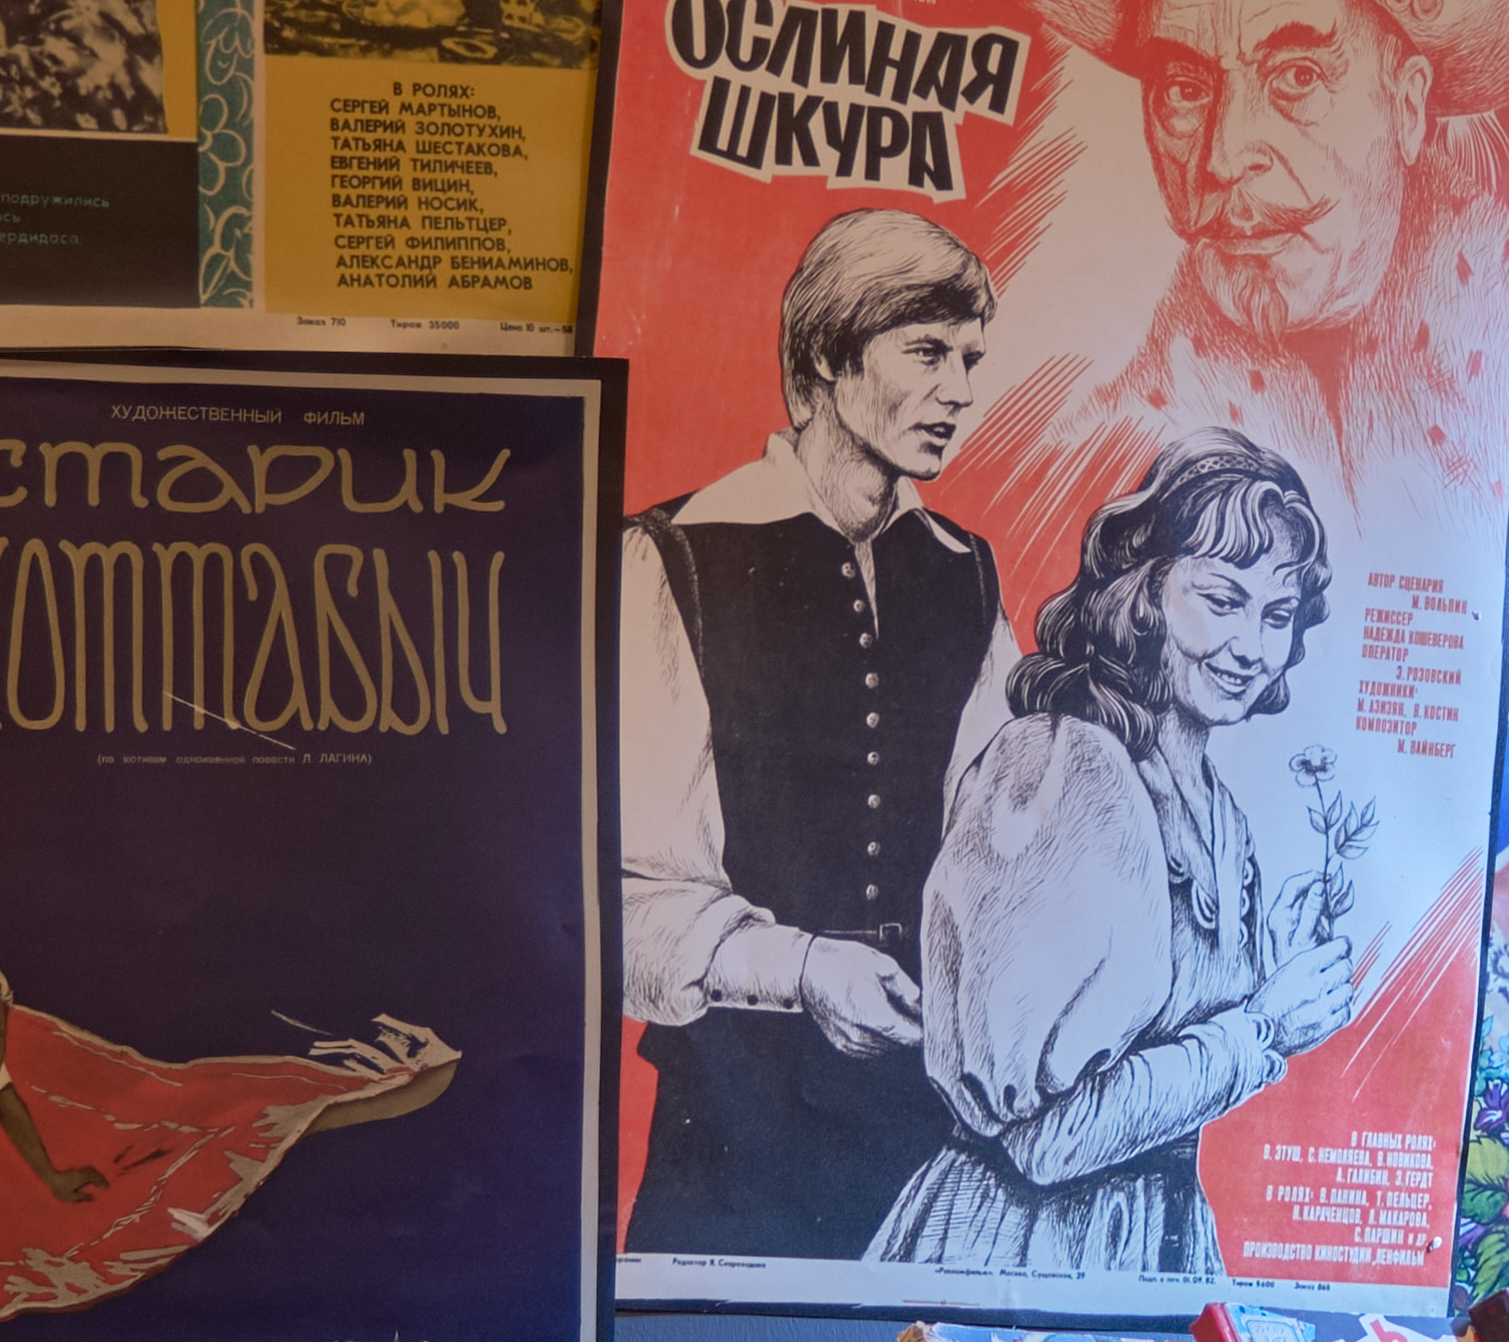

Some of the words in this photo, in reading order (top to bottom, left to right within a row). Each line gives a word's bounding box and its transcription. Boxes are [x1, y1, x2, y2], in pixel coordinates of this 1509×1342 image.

[392, 81, 402, 96] В
[412, 83, 475, 99] РОЛЯХ:
[330, 97, 390, 115] СЕРГЕЙ
[399, 102, 501, 122] МАРТЫНОВ,
[330, 116, 406, 134] ВАЛЕРИЙ
[415, 121, 526, 141] ЗОЛОТУХИН,
[696, 73, 956, 193] ШКУРА
[330, 137, 406, 154] ТАТЬЯНА
[415, 139, 529, 159] ШЕСТАКОВА,
[330, 154, 401, 172] ЕВГЕНИЙ
[411, 158, 498, 178] ТИЛИЧЕЕВ,
[330, 174, 403, 191] ГЕОРГИЙ
[411, 177, 474, 196] ВИЦИН,
[331, 192, 408, 210] ВАЛЕРИЙ
[417, 197, 484, 214] НОСИК,
[334, 213, 411, 231] ТАТЬЯНА
[421, 216, 512, 236] ПЕЛЬТЦЕР,
[334, 232, 395, 251] СЕРГЕЙ
[406, 235, 511, 253] ФИЛИППОВ,
[336, 255, 442, 273] АЛЕКСАНДР
[450, 256, 574, 274] БЕНИАМИНОВ,
[337, 271, 437, 289] АНАТОЛИЙ
[448, 274, 533, 291] АБРАМОВ
[111, 405, 282, 423] ХУДОЖЕСТВЕННЫЙ
[303, 411, 365, 426] ФИЛЬМ
[1368, 572, 1395, 589] АВТОР
[1399, 575, 1444, 594] СЦЕНАРИЯ
[1365, 607, 1413, 626] РЕЖИССЕР
[1363, 626, 1405, 645] НАДЕЖДА
[1408, 629, 1464, 649] КОШЕВЕРОВА
[1362, 644, 1408, 663] ОПЕРАТОР
[1407, 667, 1461, 685] РОЗОВСКИЙ
[1424, 705, 1458, 721] КОСТИН
[1356, 716, 1417, 736] КОМПОЗИТОР
[1411, 739, 1456, 758] ВАЙНБЕРГ
[1361, 1132, 1403, 1150] ГЛАВНЫХ
[1243, 1241, 1311, 1262] ПРОИЗВОДСТВО
